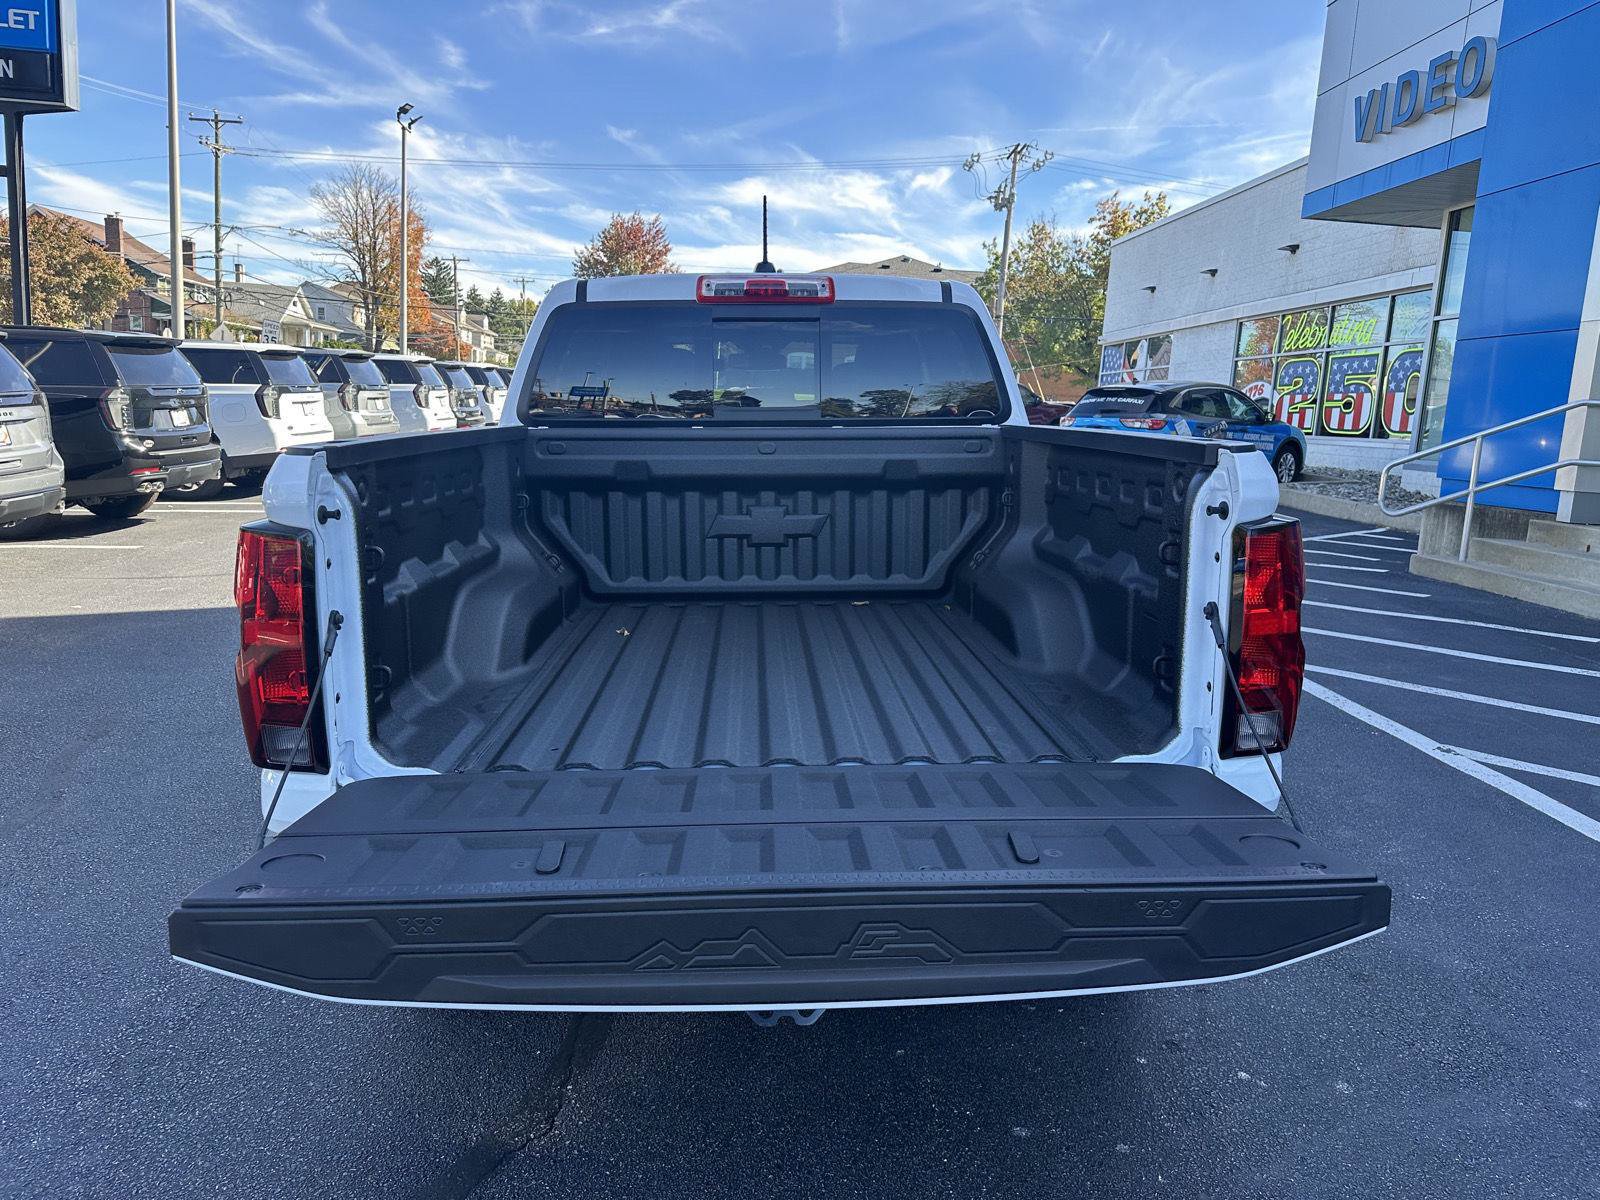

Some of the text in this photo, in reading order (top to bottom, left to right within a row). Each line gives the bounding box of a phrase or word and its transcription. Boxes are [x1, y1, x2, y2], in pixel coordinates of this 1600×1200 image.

[1354, 35, 1498, 144] VIDEO
[264, 322, 280, 330] SPEED
[262, 334, 277, 344] 35
